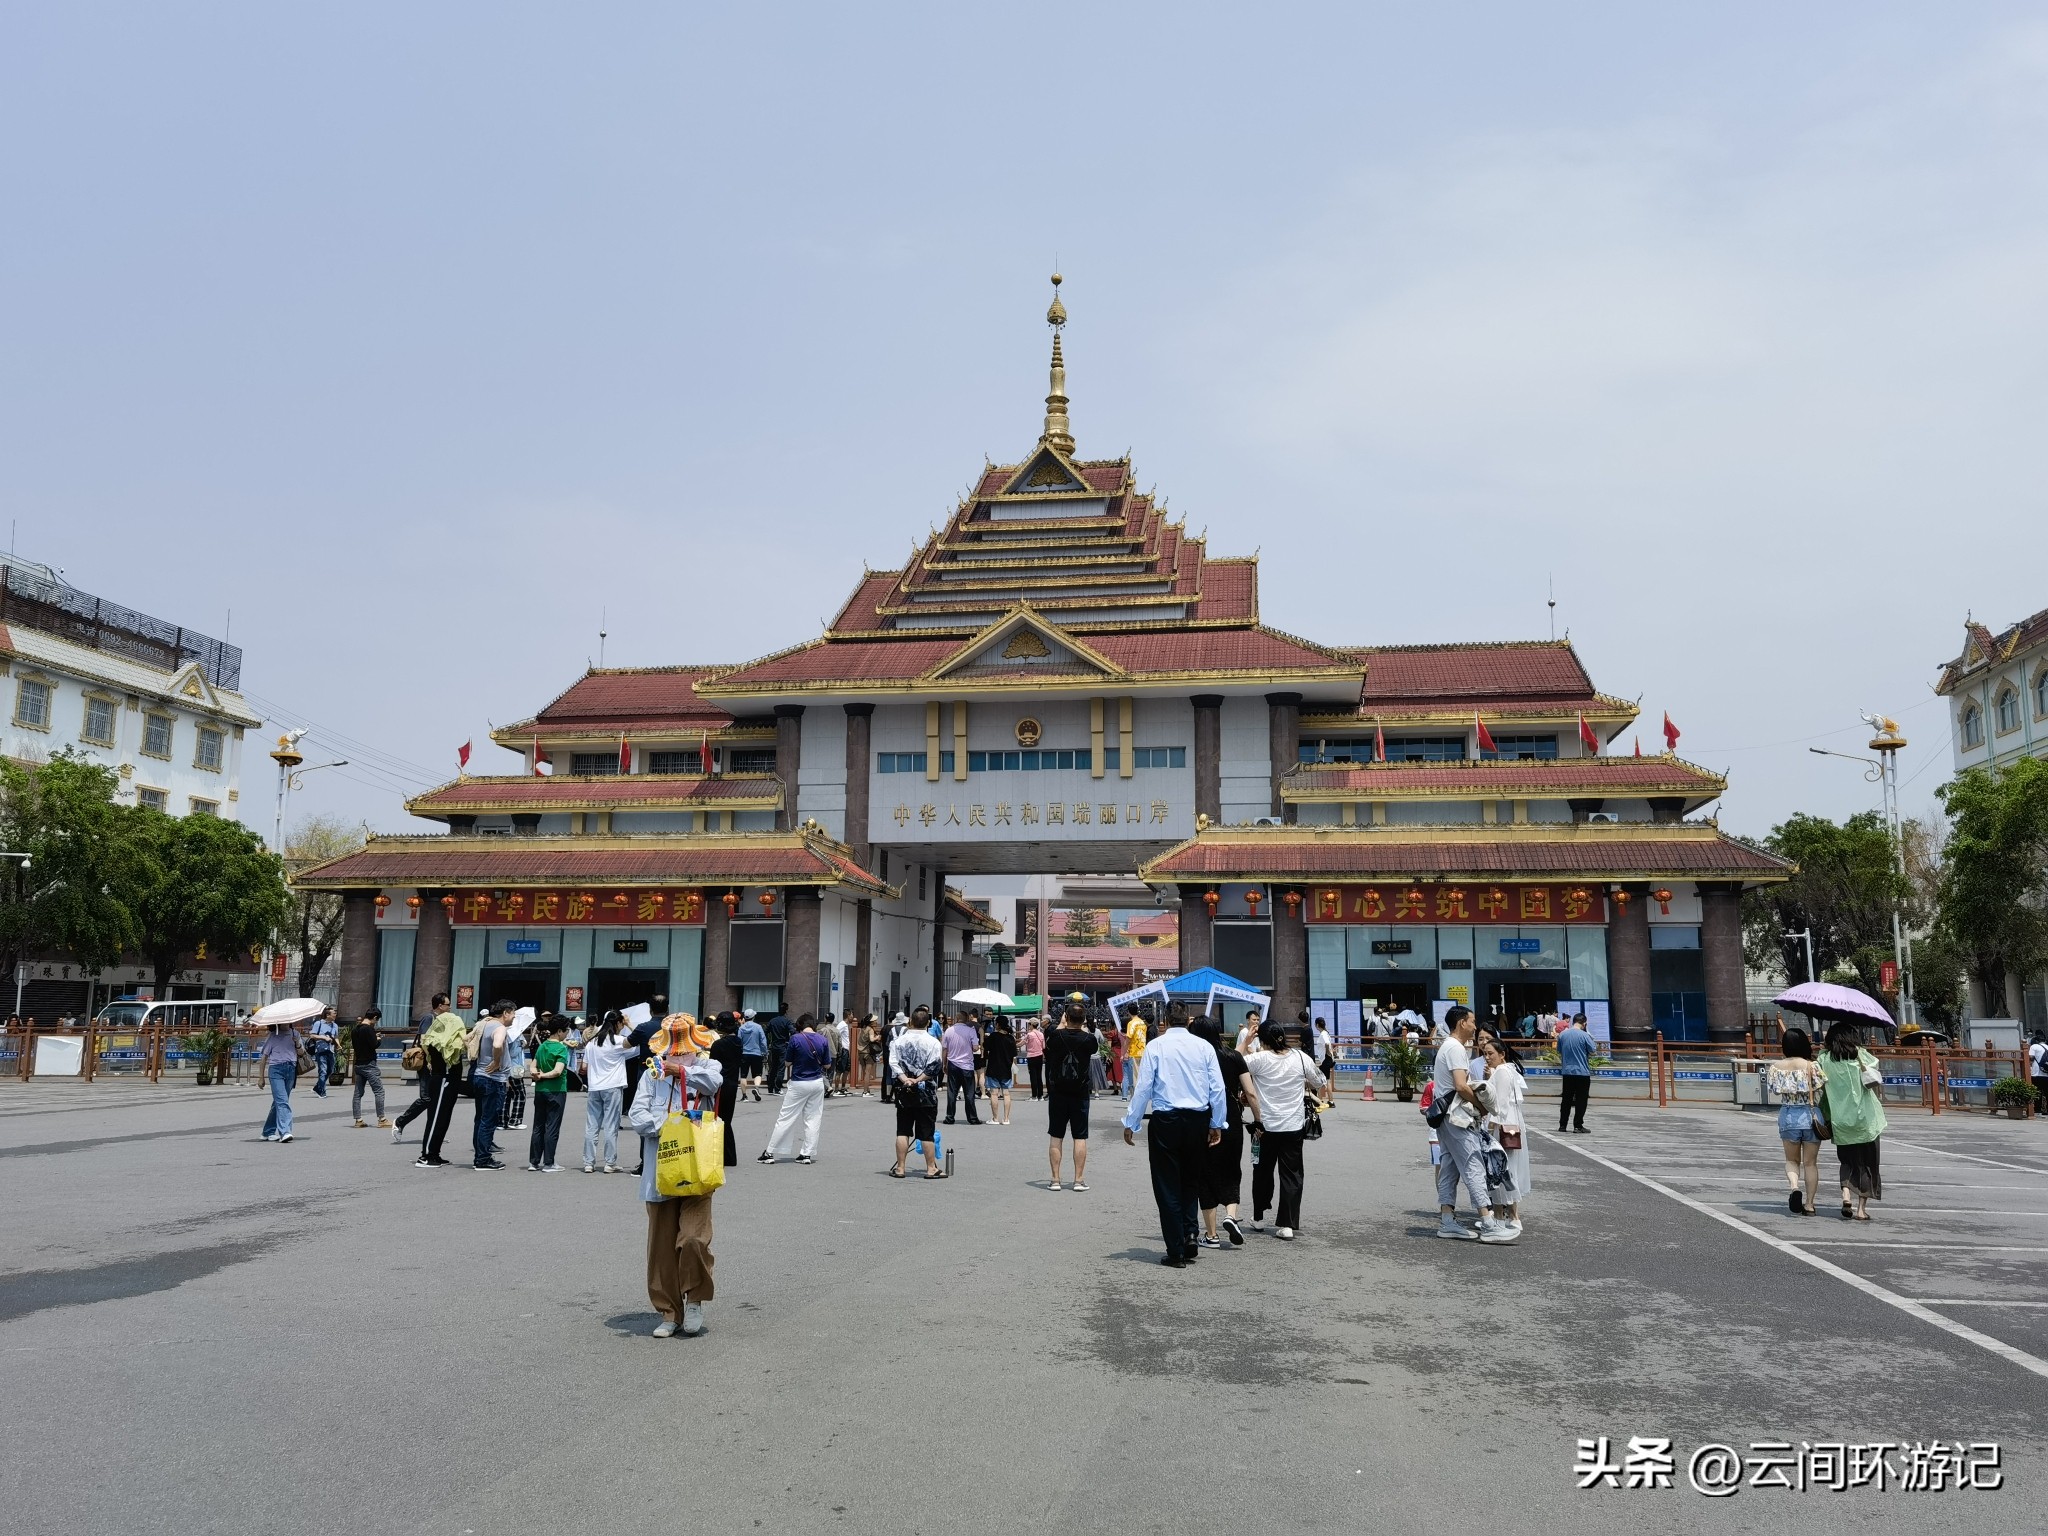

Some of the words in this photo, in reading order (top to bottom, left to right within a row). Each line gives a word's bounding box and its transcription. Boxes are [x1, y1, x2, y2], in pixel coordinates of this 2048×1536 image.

[76, 622, 97, 637] 电话
[894, 799, 1168, 827] 中华人民共和国瑞丽口岸
[463, 891, 701, 921] 中华民族一家亲
[1314, 887, 1594, 920] 同心共筑中国梦
